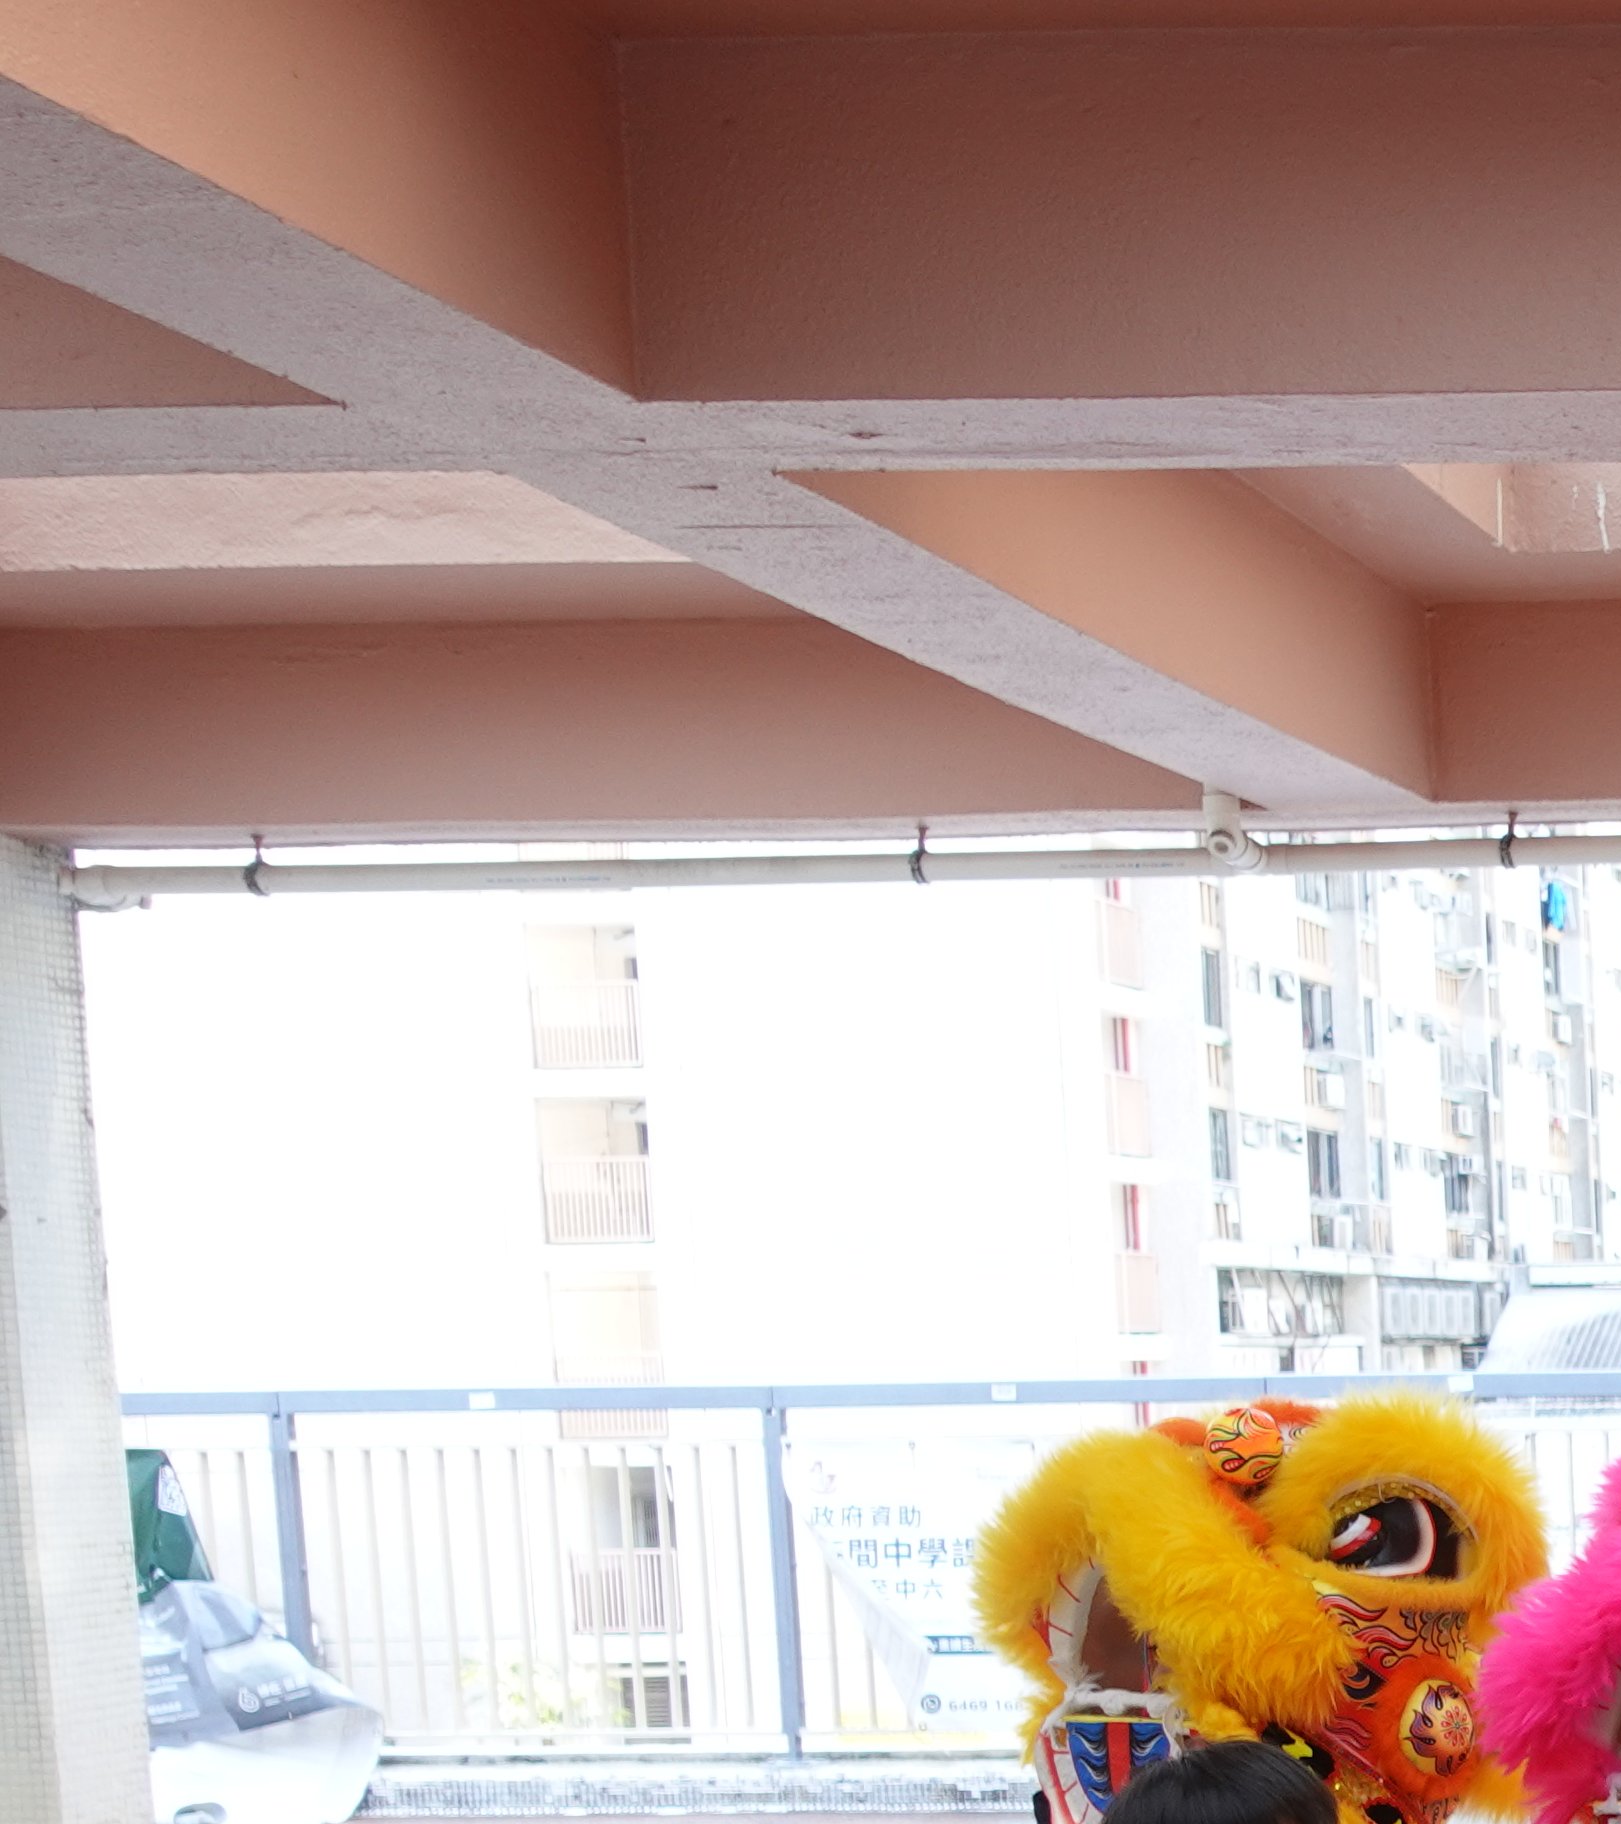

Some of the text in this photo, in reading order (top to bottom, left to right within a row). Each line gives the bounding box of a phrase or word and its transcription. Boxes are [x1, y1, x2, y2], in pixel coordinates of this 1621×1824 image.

[810, 1504, 922, 1529] 政府資助
[832, 1536, 976, 1569] 間中學課
